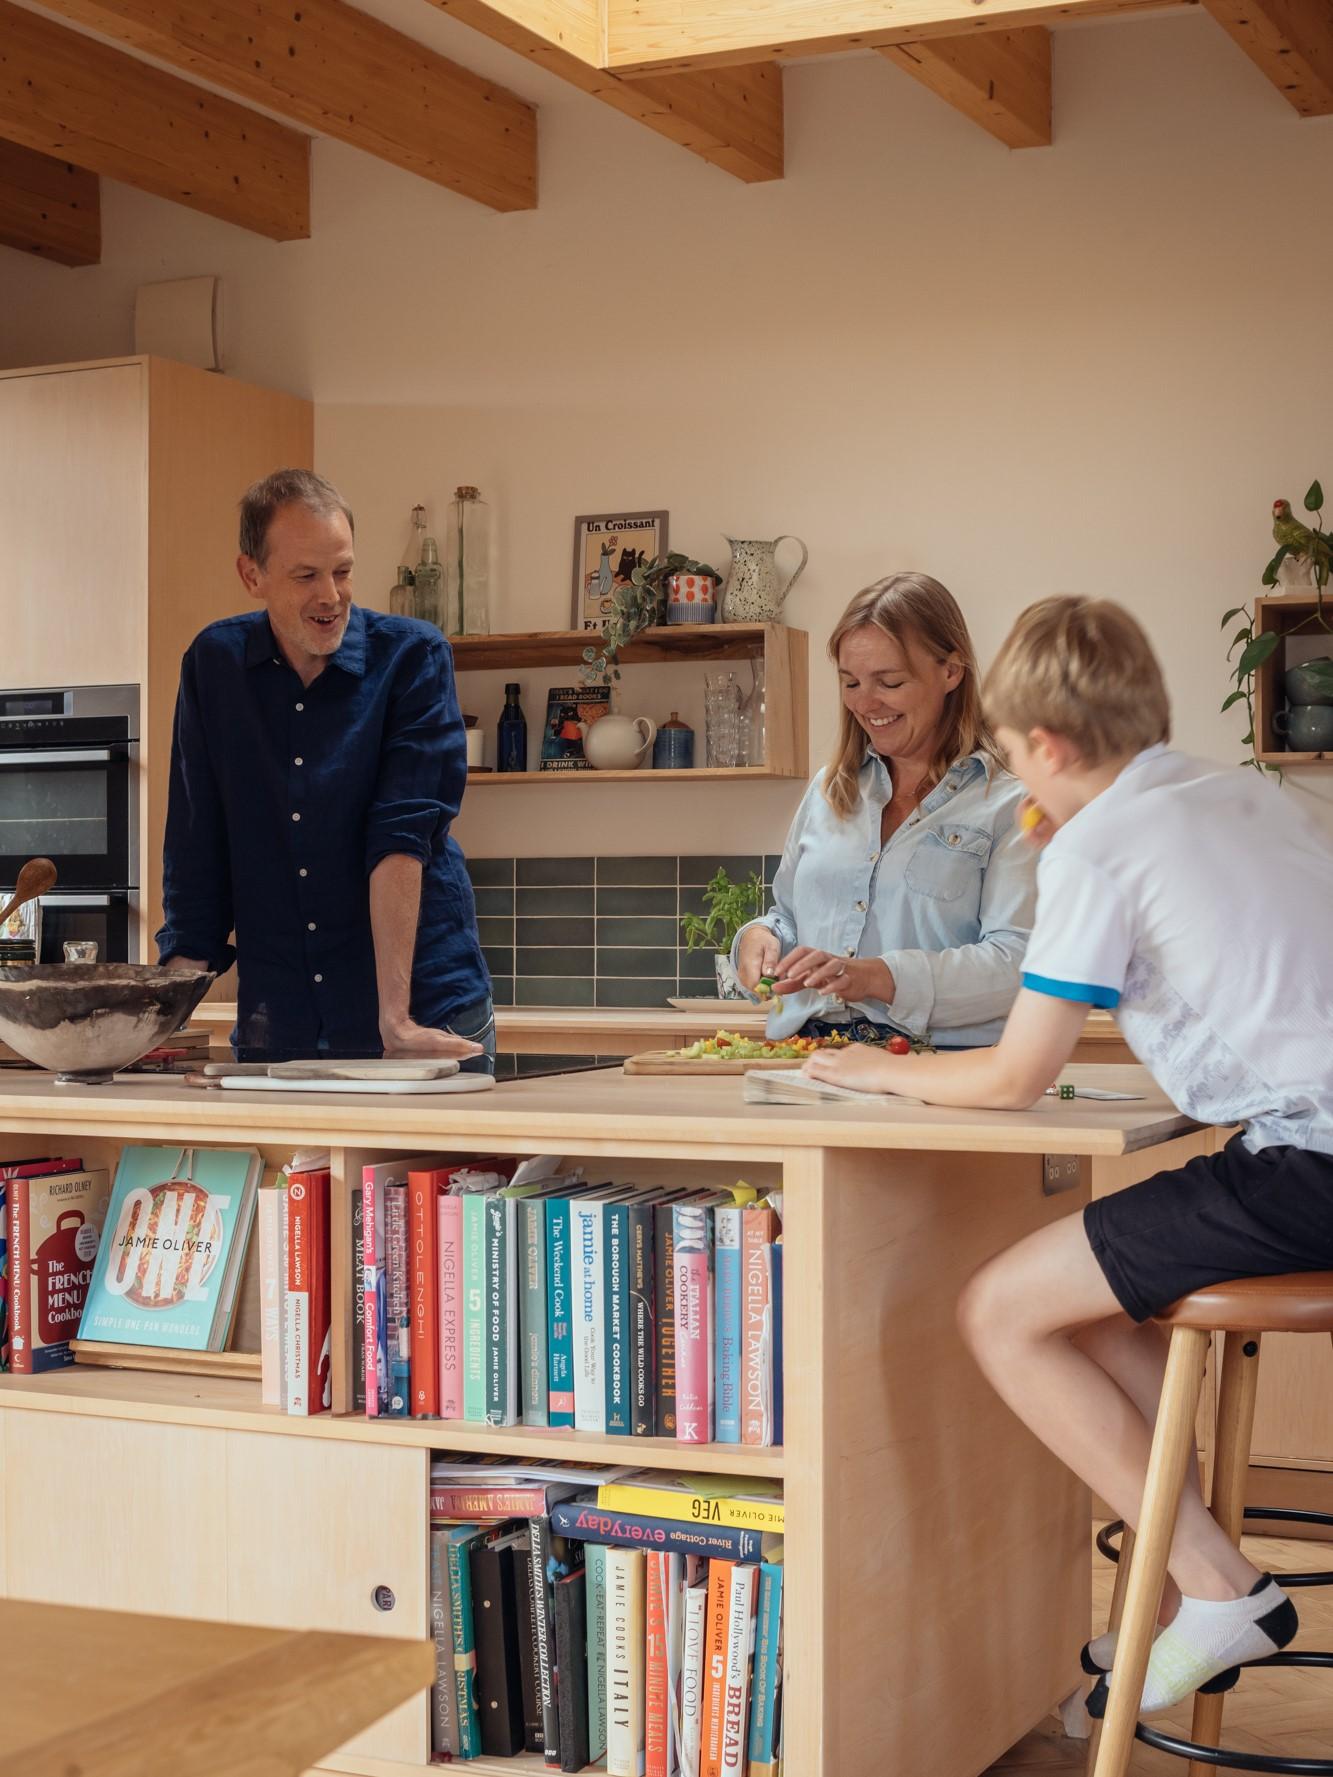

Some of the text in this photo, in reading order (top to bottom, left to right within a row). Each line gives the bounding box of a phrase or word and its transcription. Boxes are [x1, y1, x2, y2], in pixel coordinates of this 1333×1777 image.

[587, 518, 656, 533] Un Croissant
[584, 620, 598, 630] Et
[577, 760, 592, 768] WI
[49, 1180, 92, 1196] RICHARD OLNEY
[12, 1203, 20, 1219] The
[365, 1181, 374, 1254] Gary Mehigan's
[552, 1216, 563, 1239] The
[104, 1187, 231, 1301] ONE
[118, 1236, 213, 1253] JAMIE OLIVER
[391, 1200, 403, 1315] Little Green Kitchen
[553, 1240, 564, 1288] Weekend
[13, 1260, 21, 1287] MENU
[48, 1260, 65, 1273] The
[294, 1251, 302, 1286] LAWSON
[356, 1239, 365, 1324] MEAT BOOK
[415, 1191, 424, 1339] OTTOLENGHI
[491, 1239, 500, 1290] MINISTRY
[578, 1211, 598, 1322] jamie at home
[636, 1249, 644, 1289] MATTHEWS
[663, 1231, 674, 1311] JAMIE OLIVER
[48, 1289, 82, 1309] MENU
[444, 1241, 456, 1371] NIGELLA EXPRESS
[469, 1288, 481, 1311] 5
[492, 1294, 500, 1308] OF
[554, 1289, 565, 1318] Cook
[679, 1266, 689, 1330] COOKERY
[747, 1250, 762, 1323] NIGELLA
[13, 1289, 21, 1331] Cookbook
[48, 1310, 82, 1324] Cookbo
[94, 1316, 201, 1336] SIMPLE ONE PAN WONDERS
[265, 1306, 279, 1341] WAYS
[492, 1309, 500, 1342] FOOD
[611, 1214, 621, 1404] THE BOROUGH MARKET COOKBOOK
[690, 1283, 700, 1340] ITALIAN
[294, 1334, 302, 1379] CHRISTMAS
[365, 1302, 375, 1371] Comfort Food
[469, 1318, 481, 1380] INGREDIENTS
[637, 1330, 645, 1347] THE
[559, 1353, 567, 1378] Angela
[637, 1348, 645, 1368] WILD
[720, 1337, 733, 1380] Baking
[747, 1331, 761, 1411] LAWSON
[638, 1392, 645, 1407] GO
[722, 1382, 733, 1413] Bible
[683, 1422, 698, 1440] K
[575, 1510, 666, 1544] everyday
[691, 1498, 784, 1523] MIE OLIVER VEG
[670, 1532, 706, 1545] Cottage
[708, 1536, 732, 1549] River
[432, 1591, 445, 1653] NIGELLA
[530, 1523, 552, 1707] DELIA SMITH'S WINTER COLLECTION
[449, 1547, 469, 1728] DELIA SMITH'S CRISTMAS
[613, 1566, 629, 1729] JAMIE COOKS ITALY
[687, 1617, 700, 1661] LOVE
[597, 1664, 606, 1704] NIGELLA
[649, 1661, 664, 1706] MINUTE
[709, 1576, 725, 1761] JAMIE OLIVER 5 INGREDIENTS MEDITERRANEAN
[724, 1581, 745, 1768] Paul Hollywood's BREAD
[759, 1655, 768, 1681] BOOK
[436, 1662, 448, 1728] LAWSON
[756, 1694, 766, 1728] BAKING
[598, 1706, 606, 1750] LAWSON
[648, 1712, 664, 1753] MEALS
